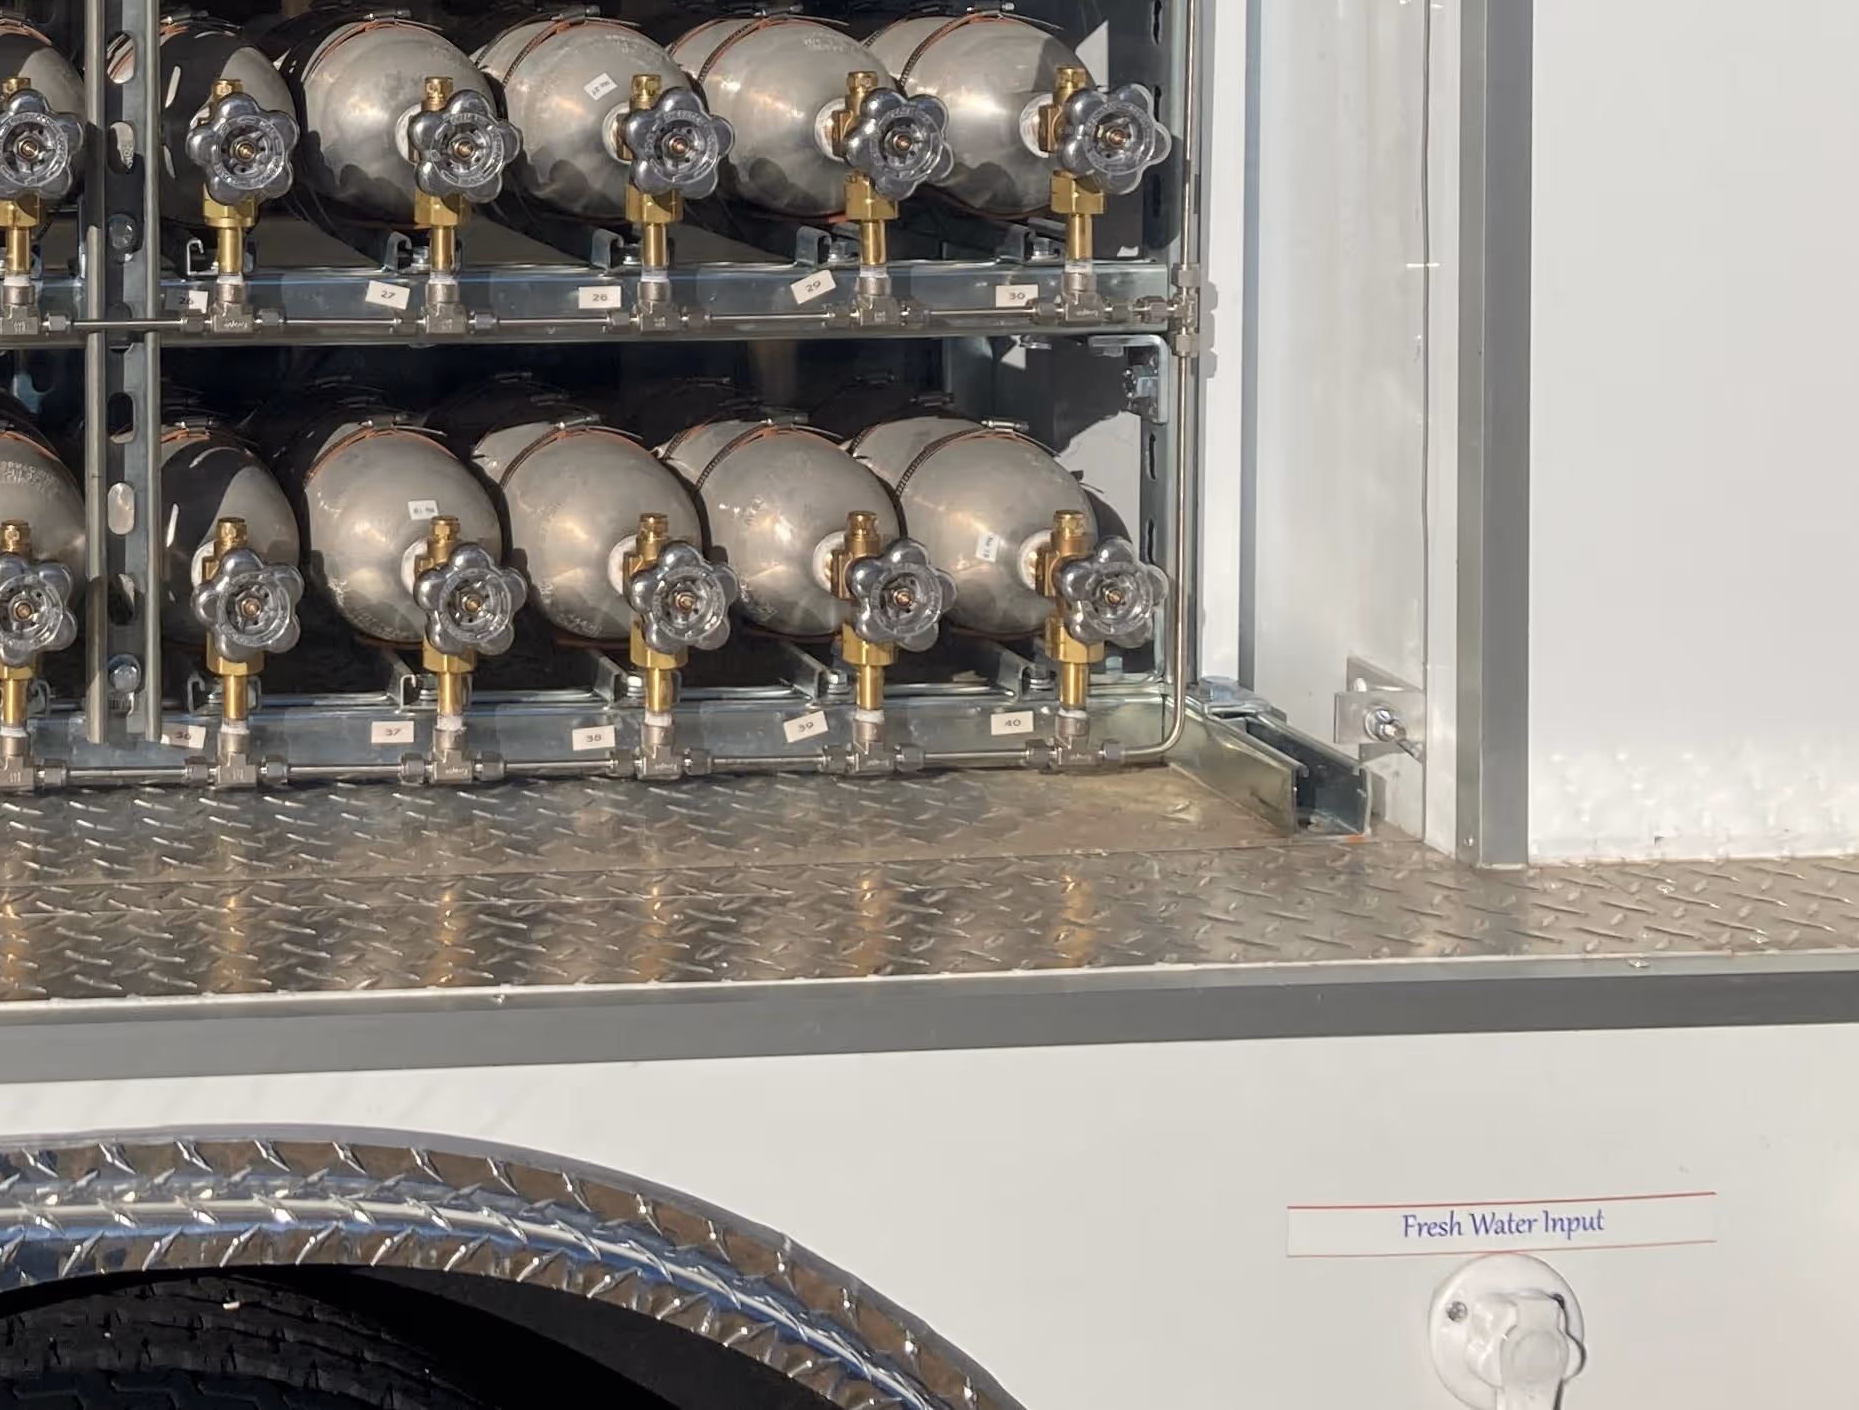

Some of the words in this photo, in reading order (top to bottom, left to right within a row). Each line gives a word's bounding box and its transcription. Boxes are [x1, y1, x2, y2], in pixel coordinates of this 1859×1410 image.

[805, 280, 822, 293] 29
[1004, 718, 1021, 727] 40
[1402, 1212, 1463, 1240] Fresh
[1469, 1211, 1538, 1237] Water
[1543, 1208, 1605, 1241] Input
